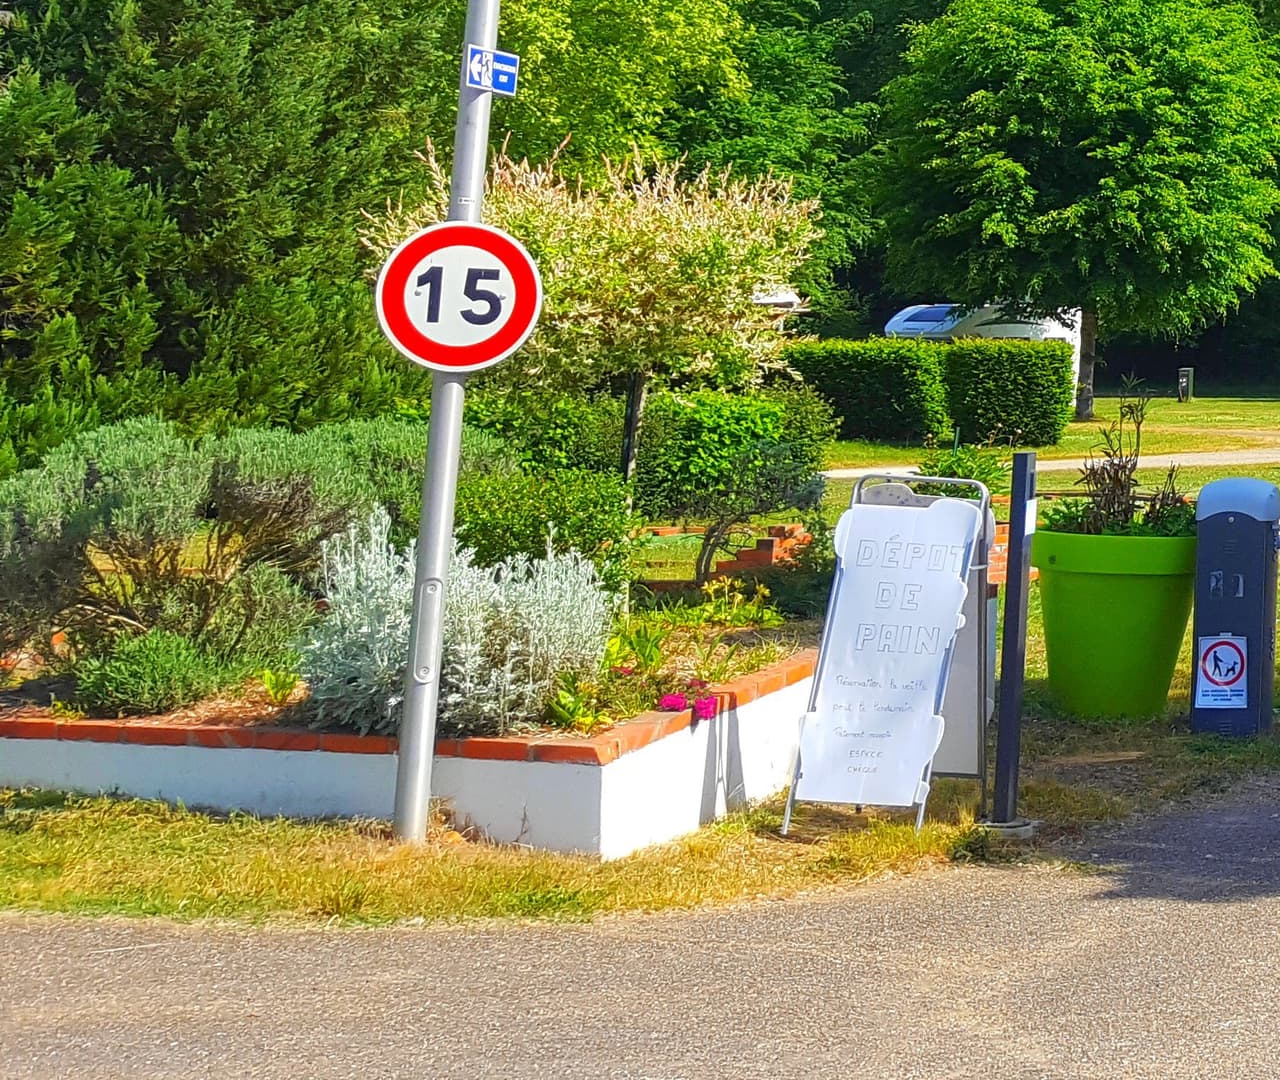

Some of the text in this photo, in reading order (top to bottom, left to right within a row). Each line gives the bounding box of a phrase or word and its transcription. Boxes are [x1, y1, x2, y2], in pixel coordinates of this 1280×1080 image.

[417, 266, 502, 325] 15
[875, 581, 923, 611] DE
[855, 623, 941, 655] PAIN
